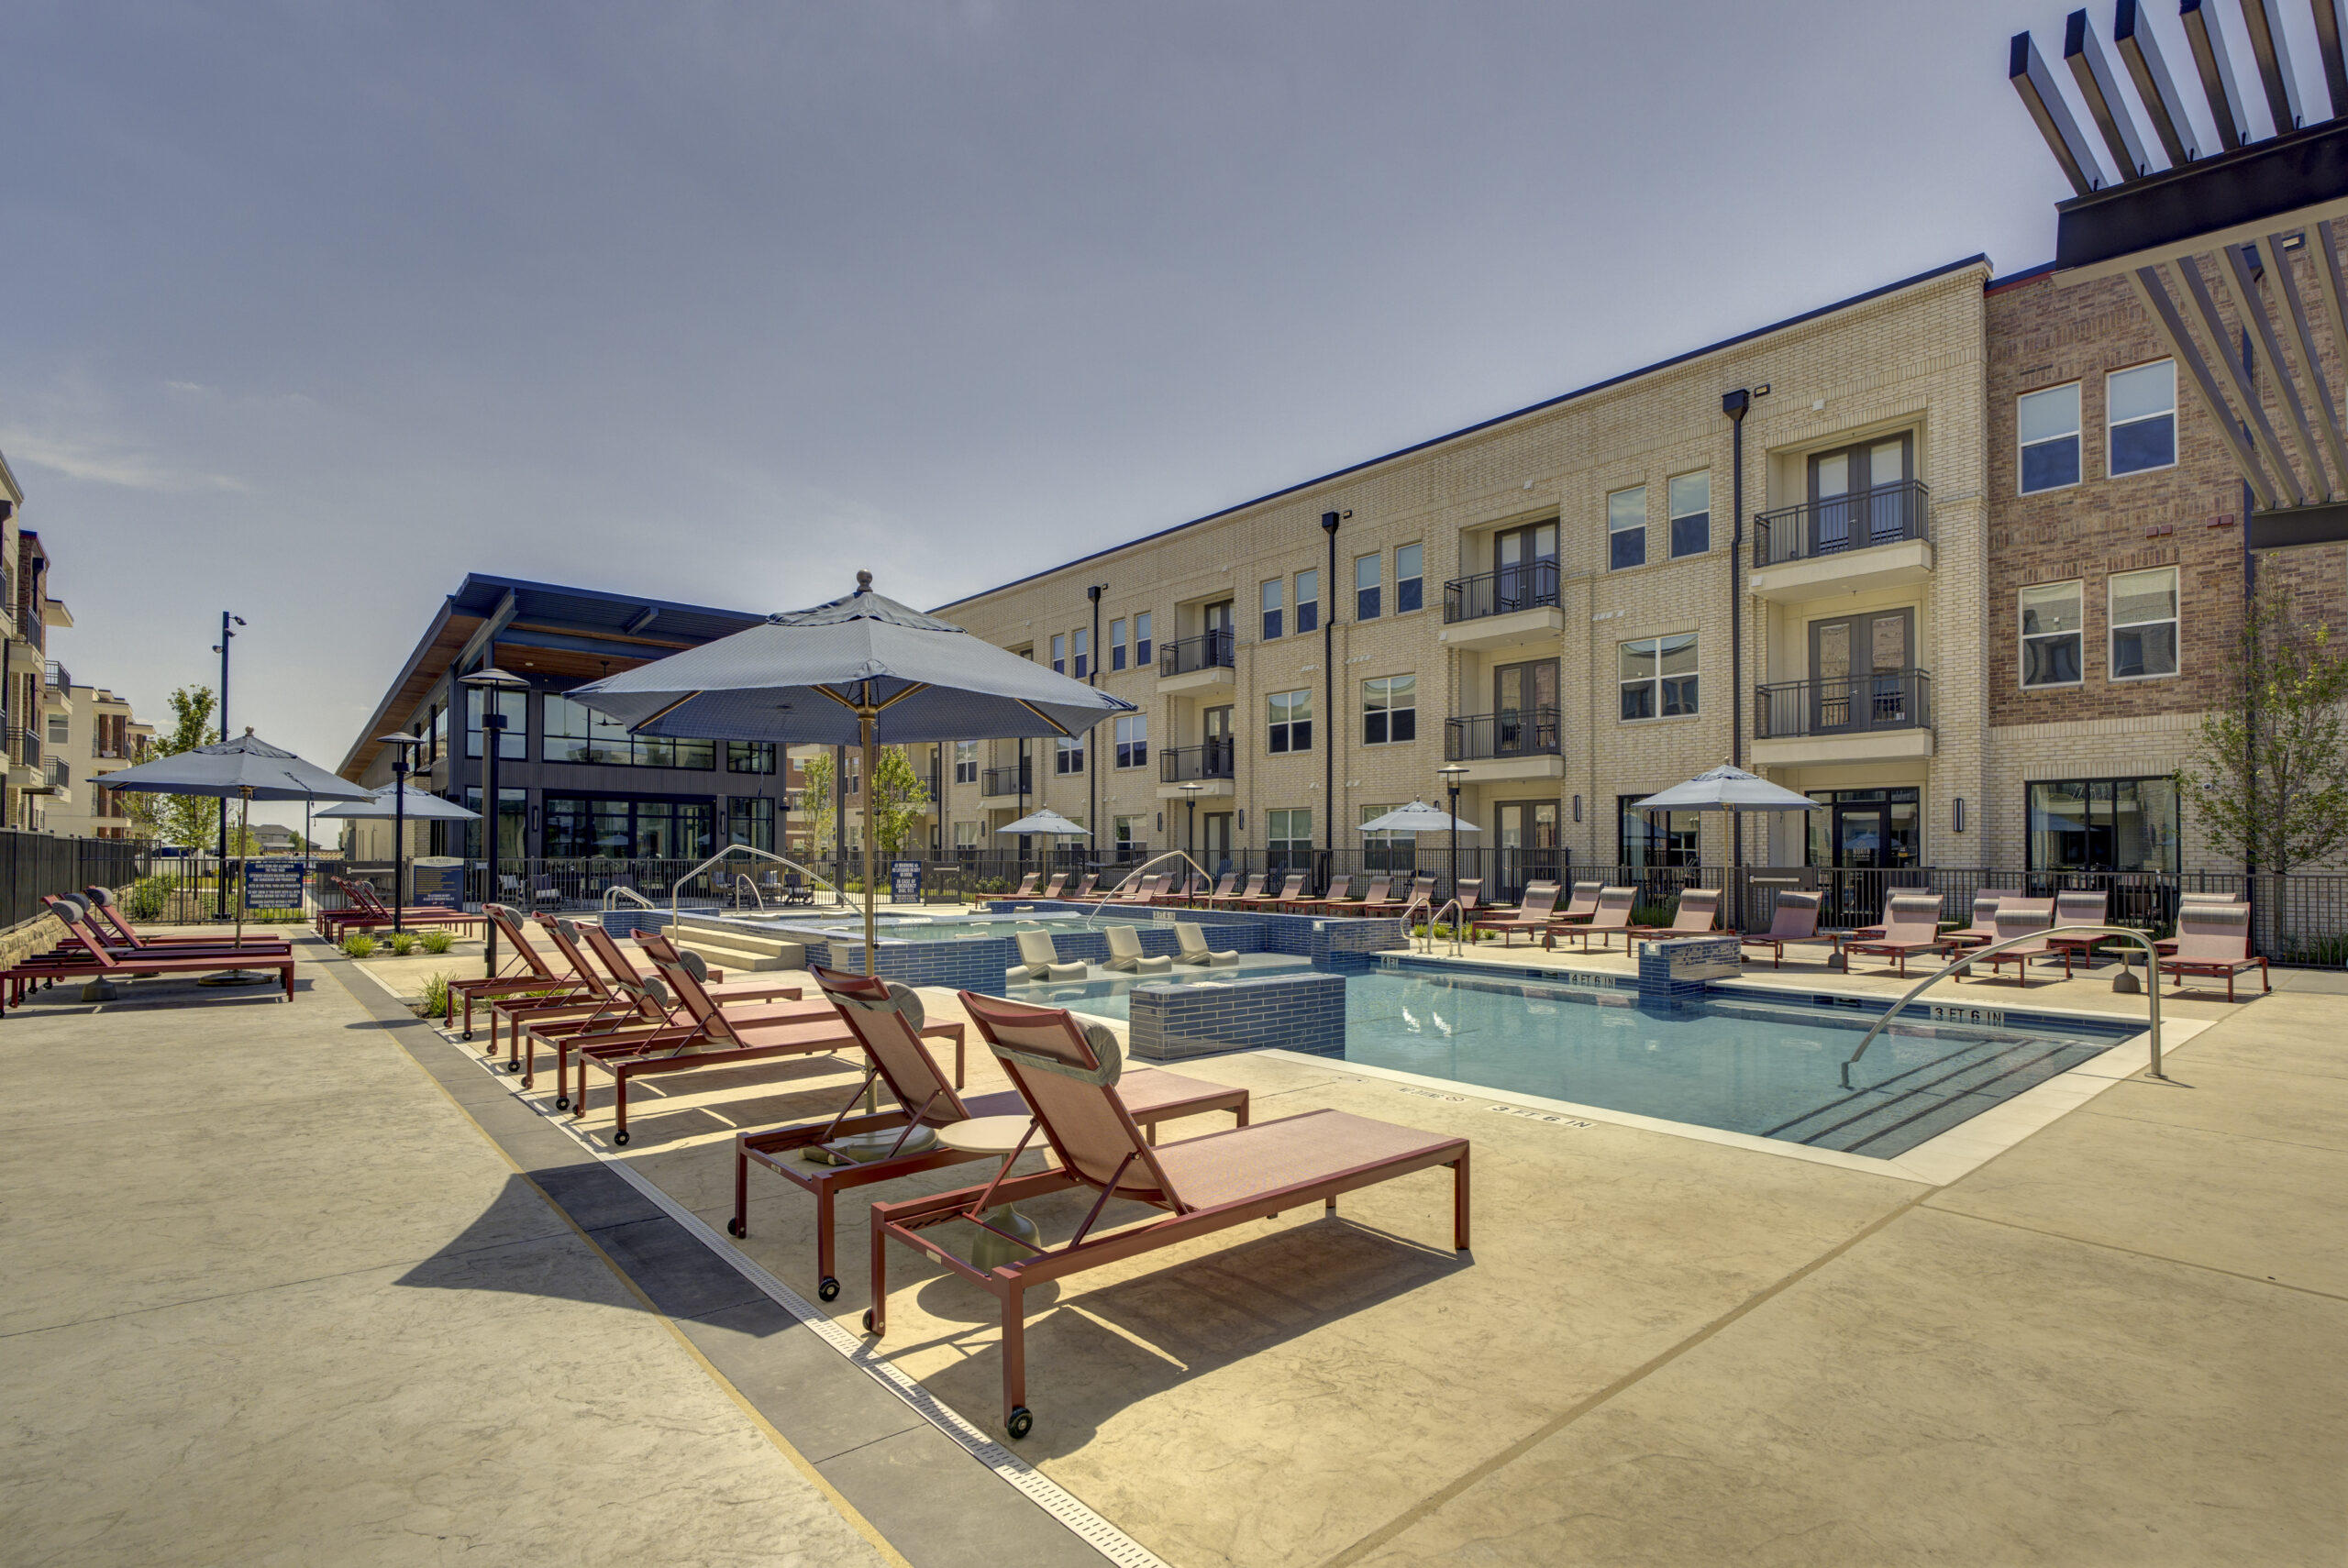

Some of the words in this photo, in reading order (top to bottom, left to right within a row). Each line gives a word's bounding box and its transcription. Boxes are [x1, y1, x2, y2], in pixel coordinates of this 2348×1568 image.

[1581, 975, 1591, 983] FT
[1605, 977, 1613, 985] IN
[1935, 1007, 1943, 1016] 3
[1949, 1008, 1965, 1018] FT
[1971, 1010, 1980, 1020] 6
[1988, 1012, 2001, 1021] IN
[1512, 1110, 1541, 1118] FT
[1564, 1120, 1592, 1129] IN
